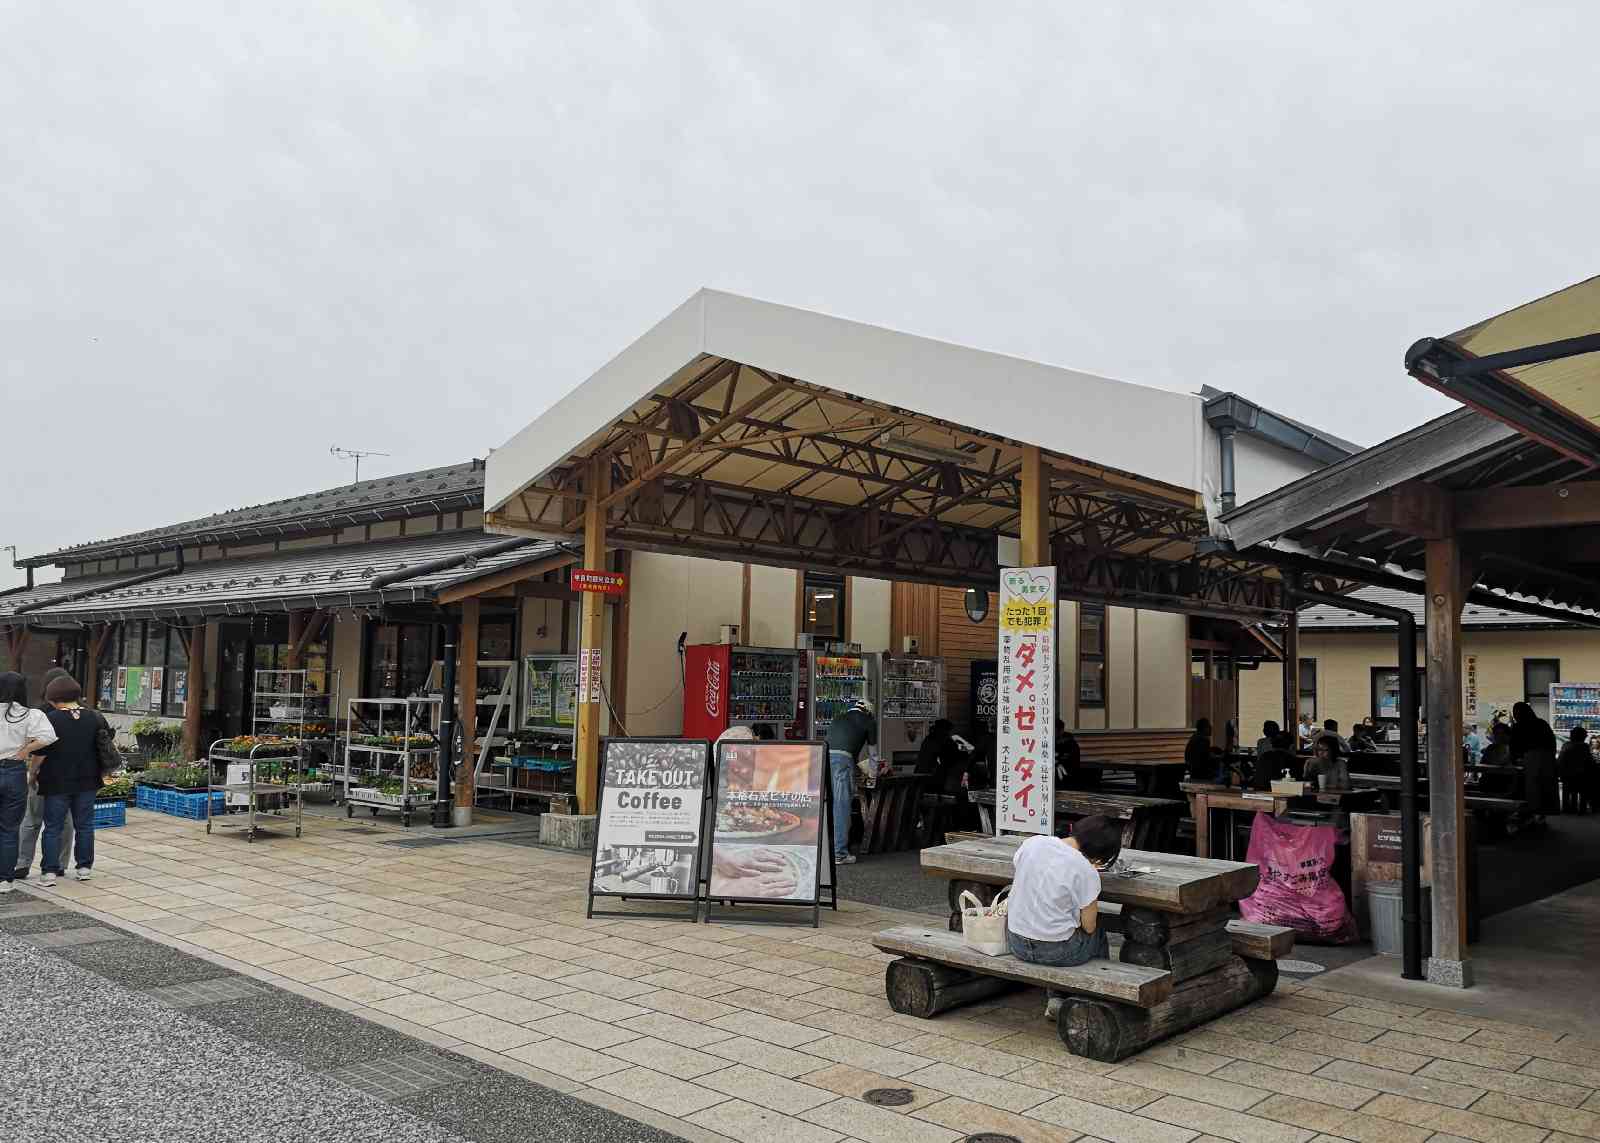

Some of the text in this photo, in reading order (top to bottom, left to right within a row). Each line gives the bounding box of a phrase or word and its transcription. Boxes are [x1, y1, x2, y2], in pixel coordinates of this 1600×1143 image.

[705, 655, 720, 717] Coca-Cola
[615, 768, 694, 786] TAKE OUT
[617, 790, 682, 810] Coffee
